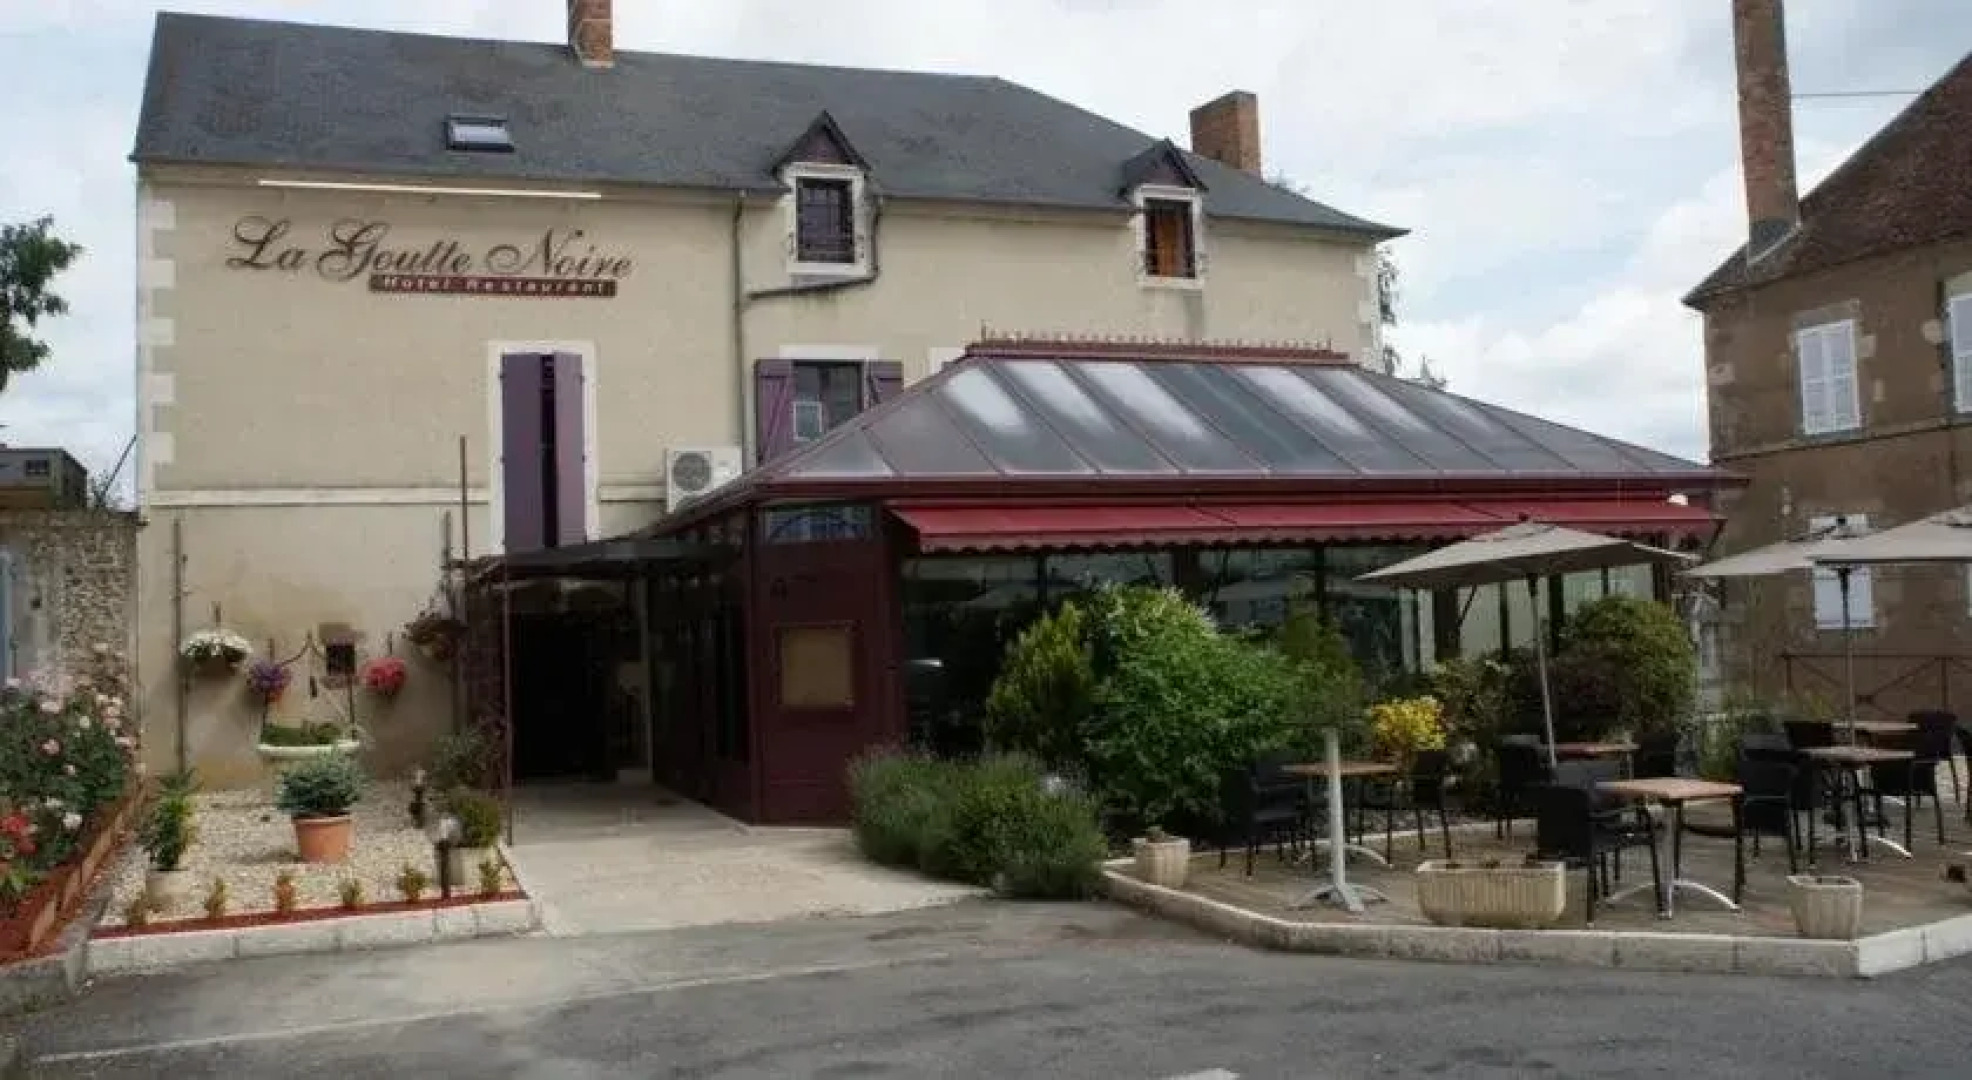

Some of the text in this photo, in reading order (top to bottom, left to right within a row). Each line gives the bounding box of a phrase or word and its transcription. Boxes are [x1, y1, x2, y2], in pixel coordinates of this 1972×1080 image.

[225, 216, 634, 281] La Goutte Noire
[466, 278, 602, 294] Restaurant
